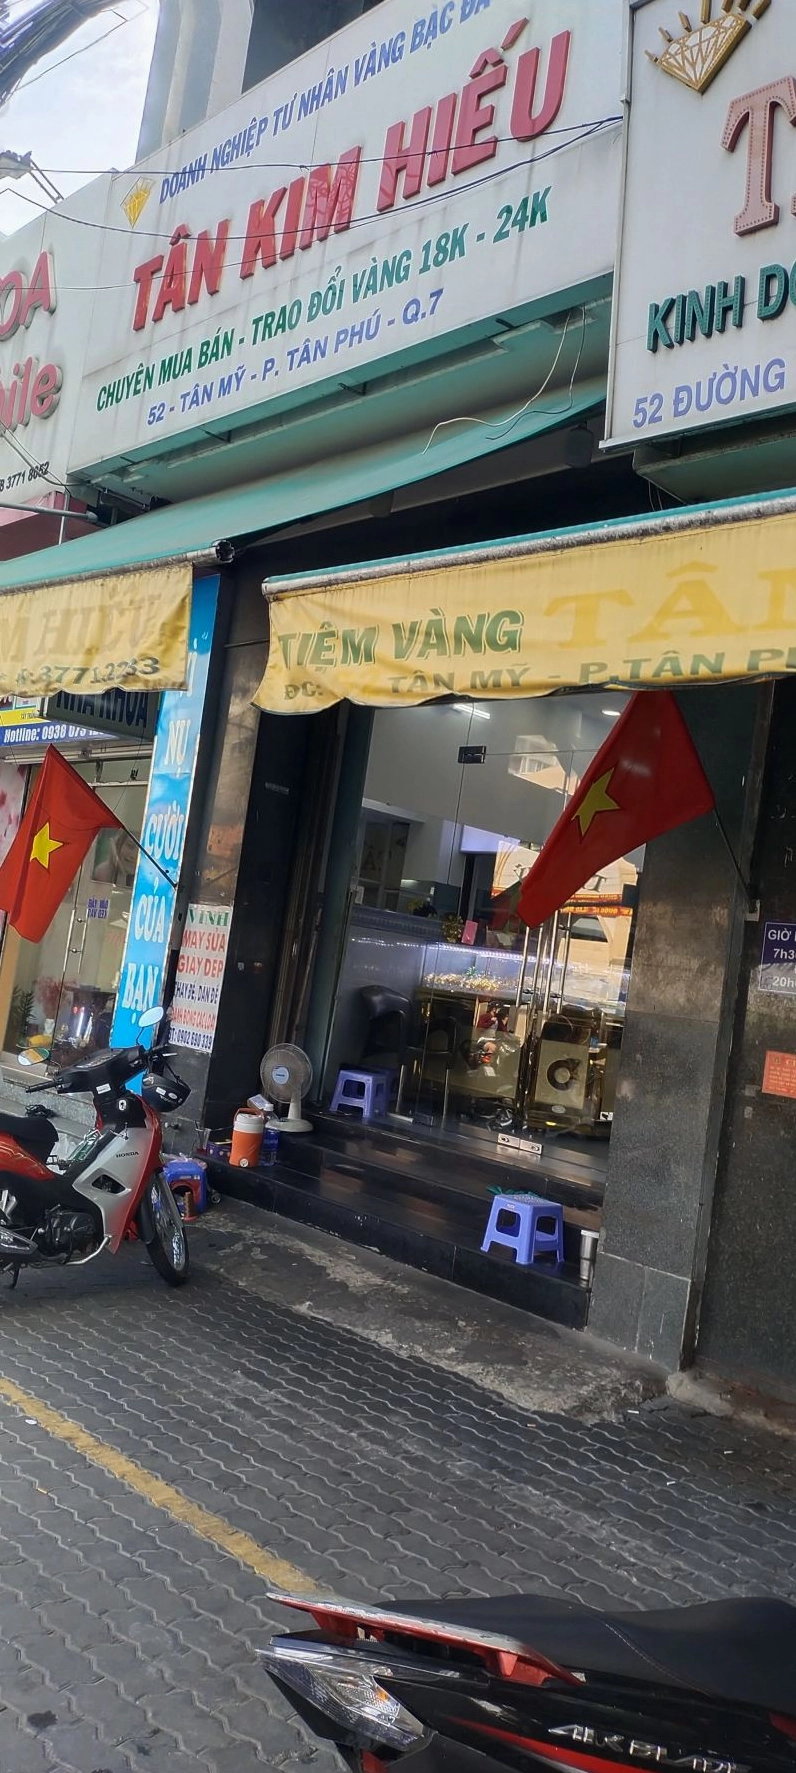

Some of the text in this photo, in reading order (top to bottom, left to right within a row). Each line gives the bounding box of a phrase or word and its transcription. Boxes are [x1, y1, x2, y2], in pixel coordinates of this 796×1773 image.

[159, 153, 208, 205] DOANH
[209, 116, 269, 174] NGHIỆP
[272, 92, 298, 137] TƯ
[297, 67, 349, 122] NHÂN
[354, 41, 407, 87] VÀNG
[409, 2, 454, 50] BẠC
[132, 17, 571, 331] TÂN KIM HIẾU
[96, 362, 155, 411] CHUYÊN
[158, 347, 192, 386] MUA
[197, 327, 235, 369] BÁN
[252, 299, 302, 346] TRAO
[307, 265, 346, 323] ĐỔI
[352, 257, 412, 304] VÀNG
[418, 222, 469, 275] 18K
[493, 186, 552, 243] 24K
[646, 275, 745, 353] KINH
[147, 402, 165, 426] 52
[180, 383, 213, 412] TÂN
[218, 365, 246, 399] MỸ
[262, 357, 279, 381] P.
[287, 337, 328, 371] TÂN
[334, 308, 382, 353] PHÚ
[403, 288, 445, 326] Q.7
[633, 358, 786, 428] 52 ĐƯỜNG
[6, 469, 26, 489] 3771
[278, 621, 379, 672] TIỆM
[392, 607, 525, 660] VÀNG
[387, 670, 454, 694] TÂN
[469, 663, 531, 690] MỸ
[4, 727, 41, 743] Hotline:
[42, 724, 67, 740] 0938
[135, 876, 165, 944] CỦA
[189, 909, 229, 927] VINH
[767, 927, 792, 942] GIỜ
[772, 975, 796, 989] 20h
[773, 949, 796, 961] 7h3
[123, 963, 158, 1025] BẠN
[115, 1150, 140, 1159] HONDA
